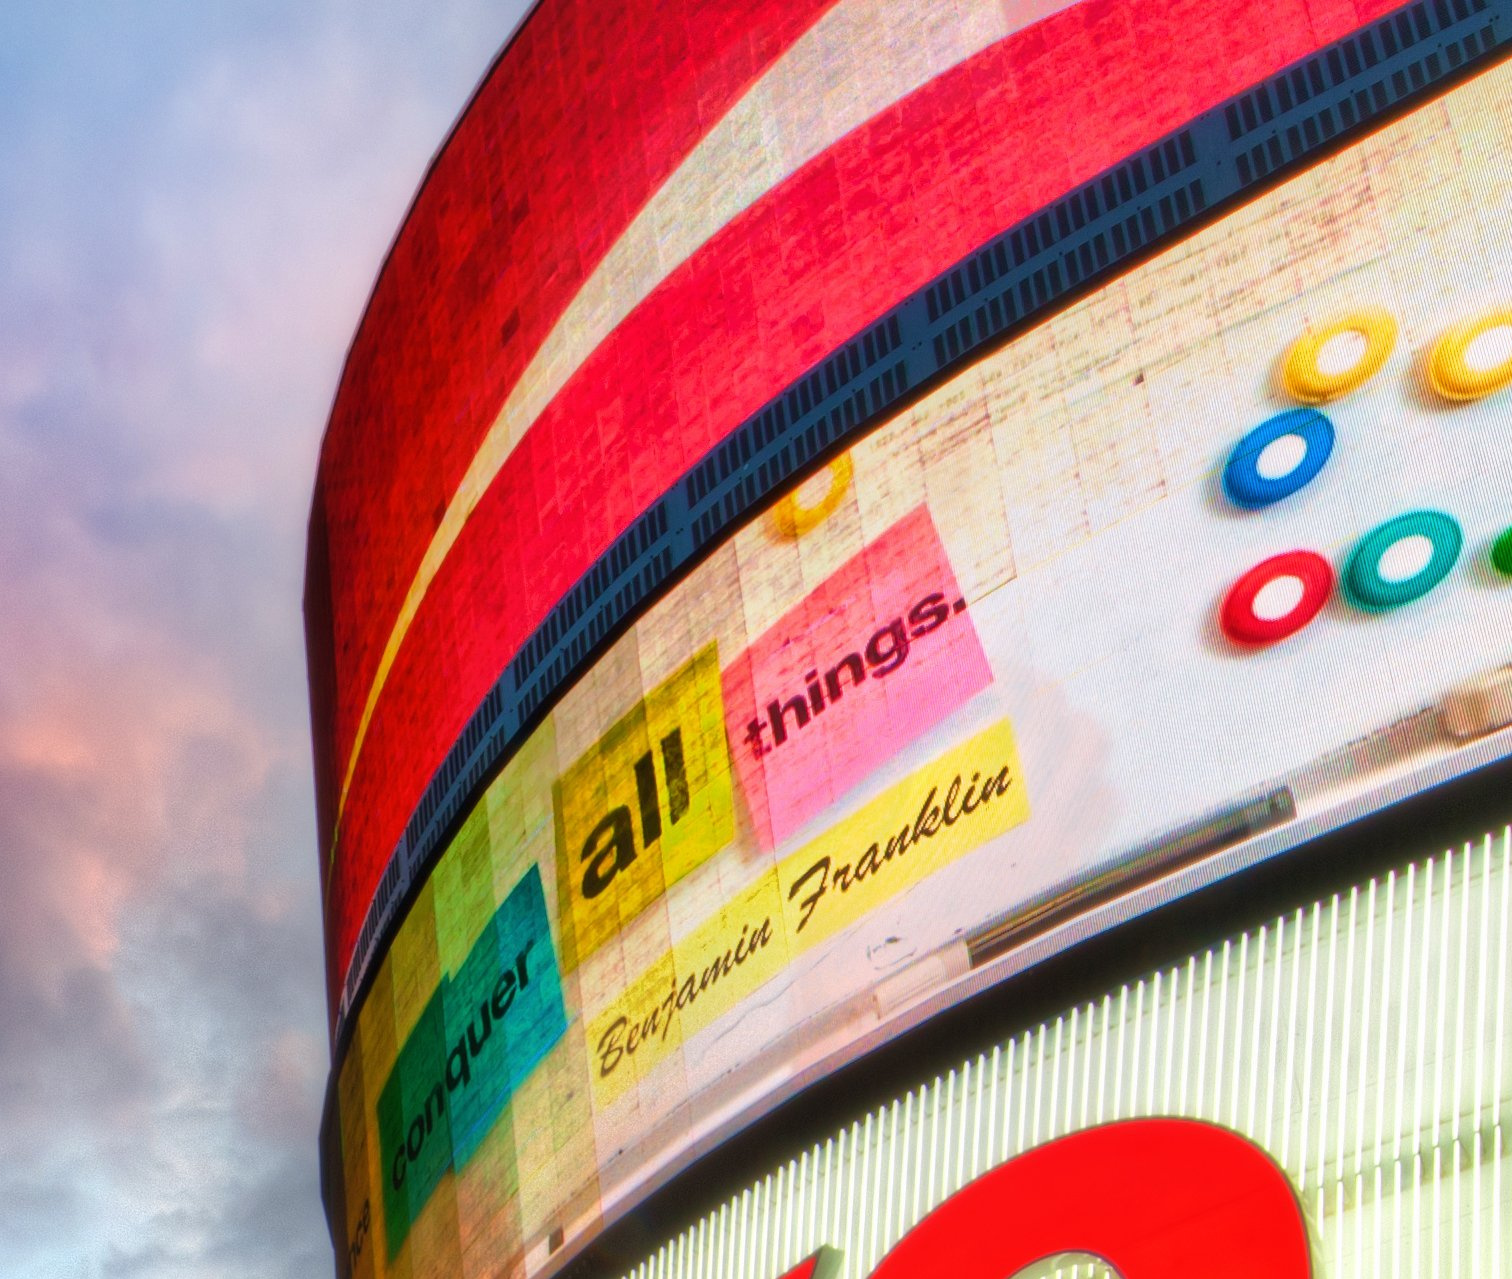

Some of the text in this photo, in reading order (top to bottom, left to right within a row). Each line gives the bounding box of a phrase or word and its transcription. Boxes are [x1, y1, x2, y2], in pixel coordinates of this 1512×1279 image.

[743, 592, 967, 761] things.
[579, 727, 690, 899] all
[596, 765, 1014, 1078] Benjamin Franklin
[391, 936, 539, 1190] conquer
